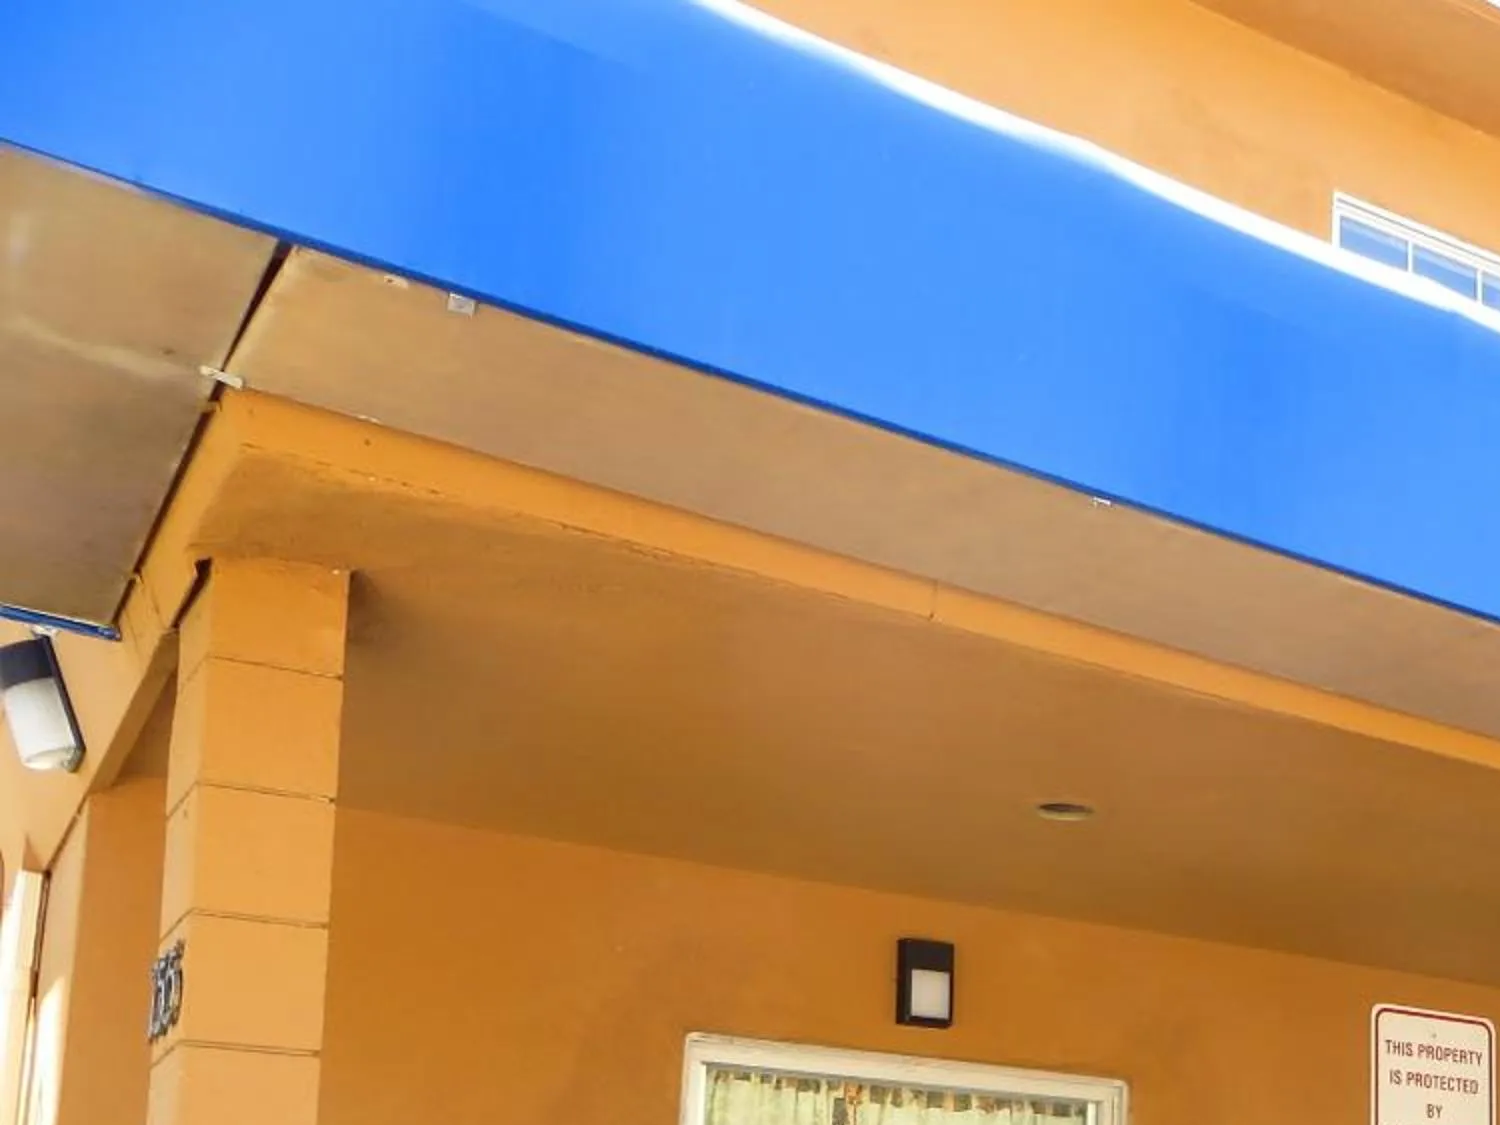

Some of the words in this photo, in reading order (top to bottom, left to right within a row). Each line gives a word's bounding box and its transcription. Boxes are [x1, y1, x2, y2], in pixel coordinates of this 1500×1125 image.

[1385, 1039, 1413, 1057] THIS
[1418, 1043, 1483, 1065] PROPERTY
[1389, 1069, 1401, 1085] IS
[1406, 1071, 1479, 1094] PROTECTED
[1426, 1104, 1443, 1119] BY
